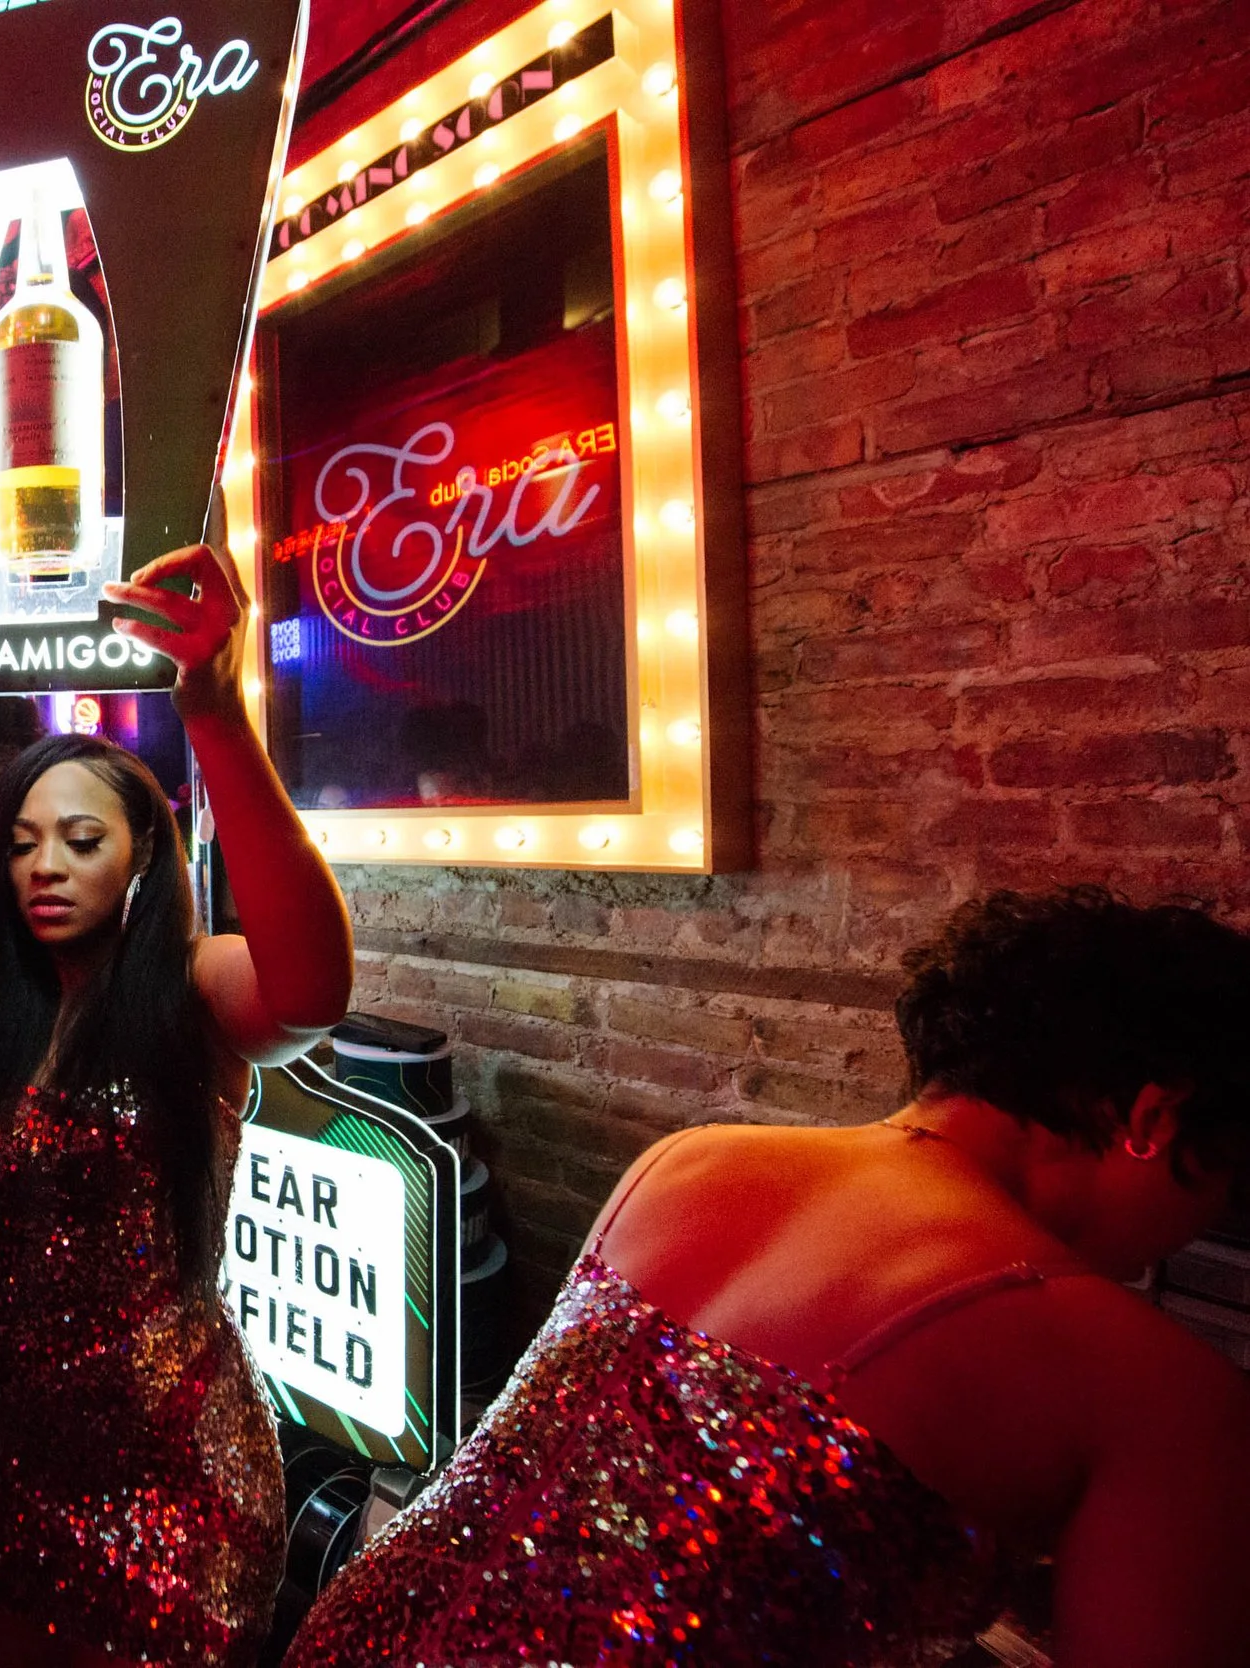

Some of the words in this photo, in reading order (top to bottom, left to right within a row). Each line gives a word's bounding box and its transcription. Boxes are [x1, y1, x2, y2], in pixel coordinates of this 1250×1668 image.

[88, 16, 259, 124] Era
[90, 78, 126, 145] SOCIAL
[140, 103, 188, 145] CLUB
[315, 421, 601, 601] Era
[395, 571, 470, 635] CLUB
[250, 1153, 338, 1230] EAR
[235, 1214, 377, 1316] OTION
[227, 1279, 373, 1389] FIELD
